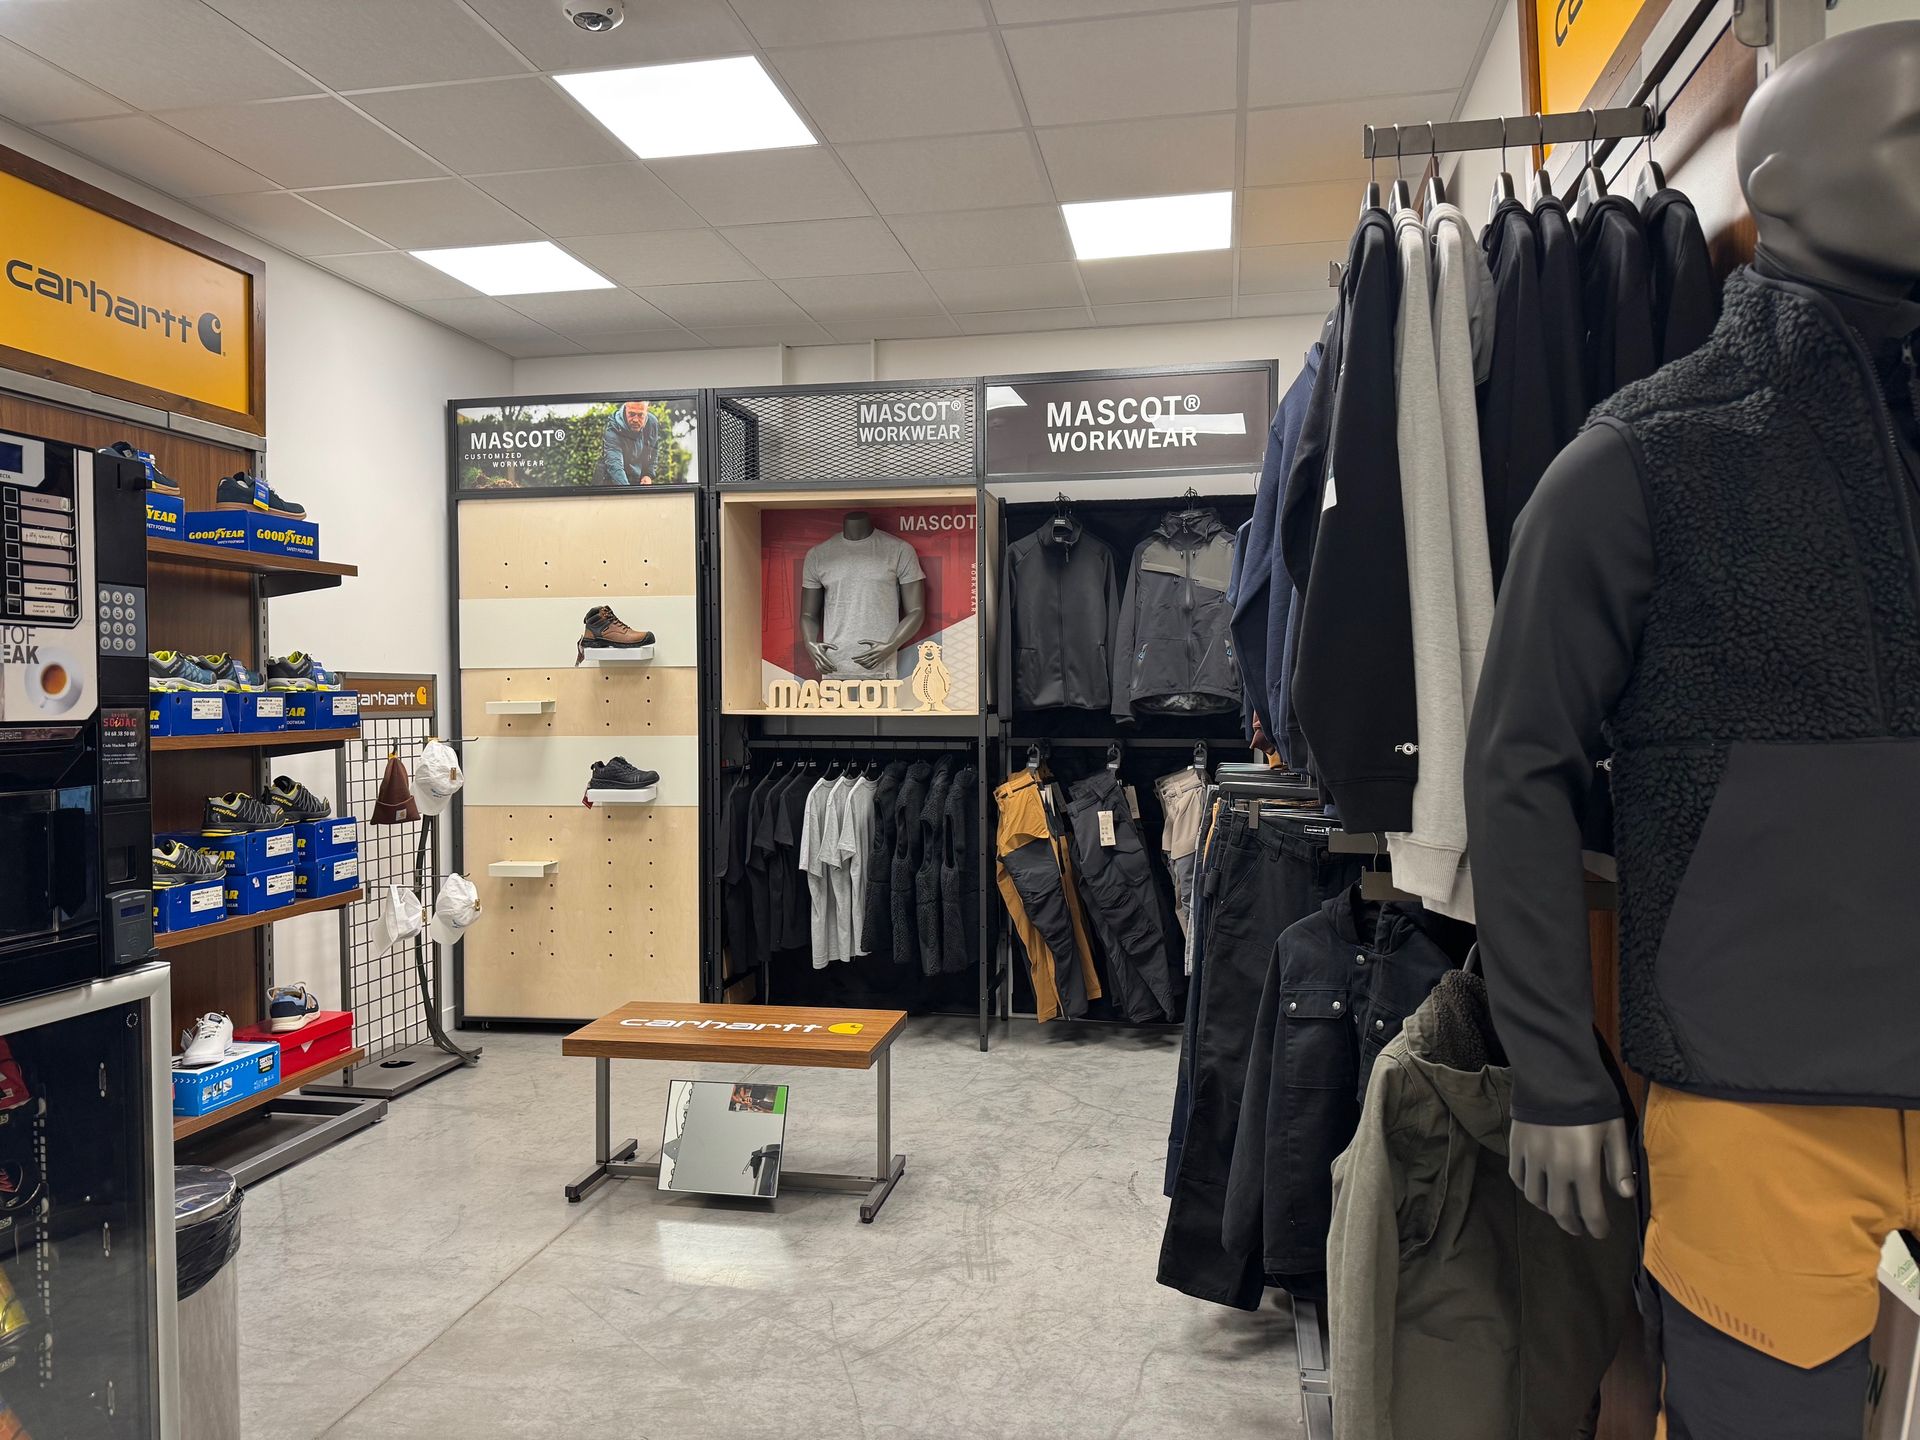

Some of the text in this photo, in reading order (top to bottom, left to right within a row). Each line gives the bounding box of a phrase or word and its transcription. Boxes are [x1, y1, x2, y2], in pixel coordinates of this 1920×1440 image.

[6, 259, 192, 343] carhartt
[859, 424, 961, 442] WORKWEAR
[1047, 426, 1198, 453] WORKWEAR
[464, 452, 522, 460] CUSTOMIZED
[492, 459, 544, 468] WORKWEAR
[900, 514, 976, 531] MASCOT
[189, 528, 245, 541] GOODYEAR
[257, 529, 314, 546] GOODYEAR
[358, 691, 415, 705] arhartt
[768, 679, 904, 709] MASCOT
[620, 1018, 822, 1033] carhartt
